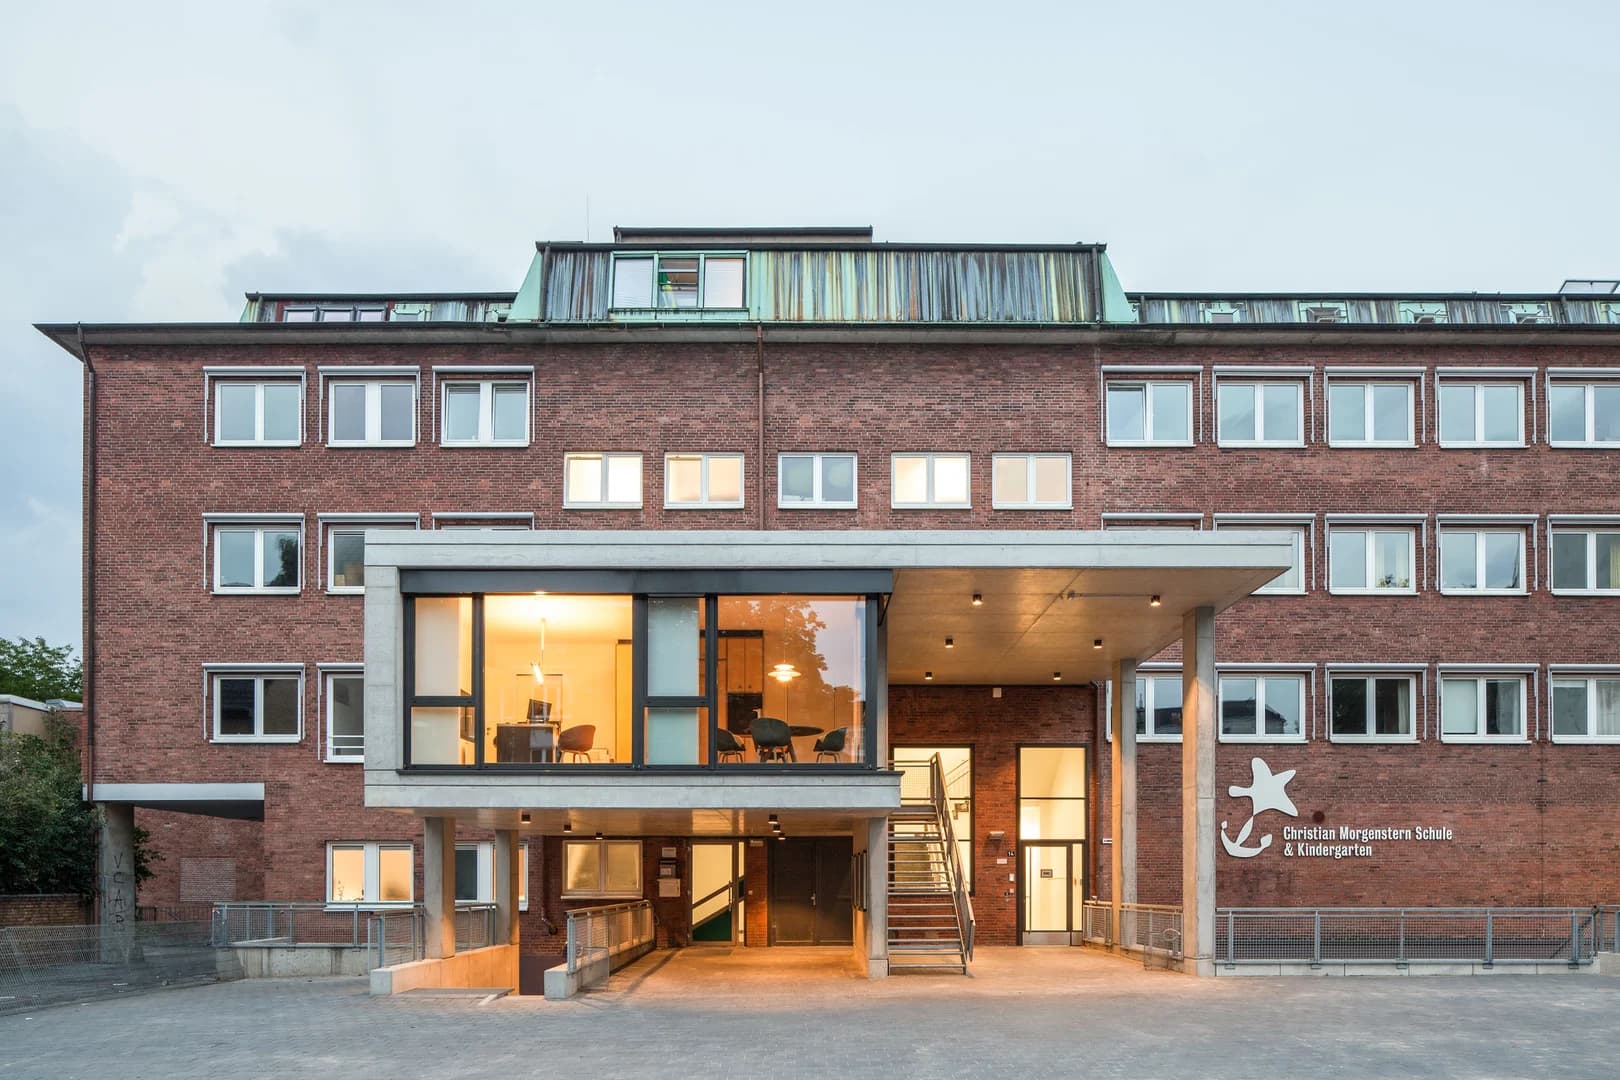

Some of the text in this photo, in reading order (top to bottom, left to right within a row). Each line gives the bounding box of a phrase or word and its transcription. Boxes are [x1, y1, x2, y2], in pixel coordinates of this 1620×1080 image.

[1283, 826, 1453, 842] Christian Morgenstern Schule
[1283, 842, 1373, 859] & Kindergarten
